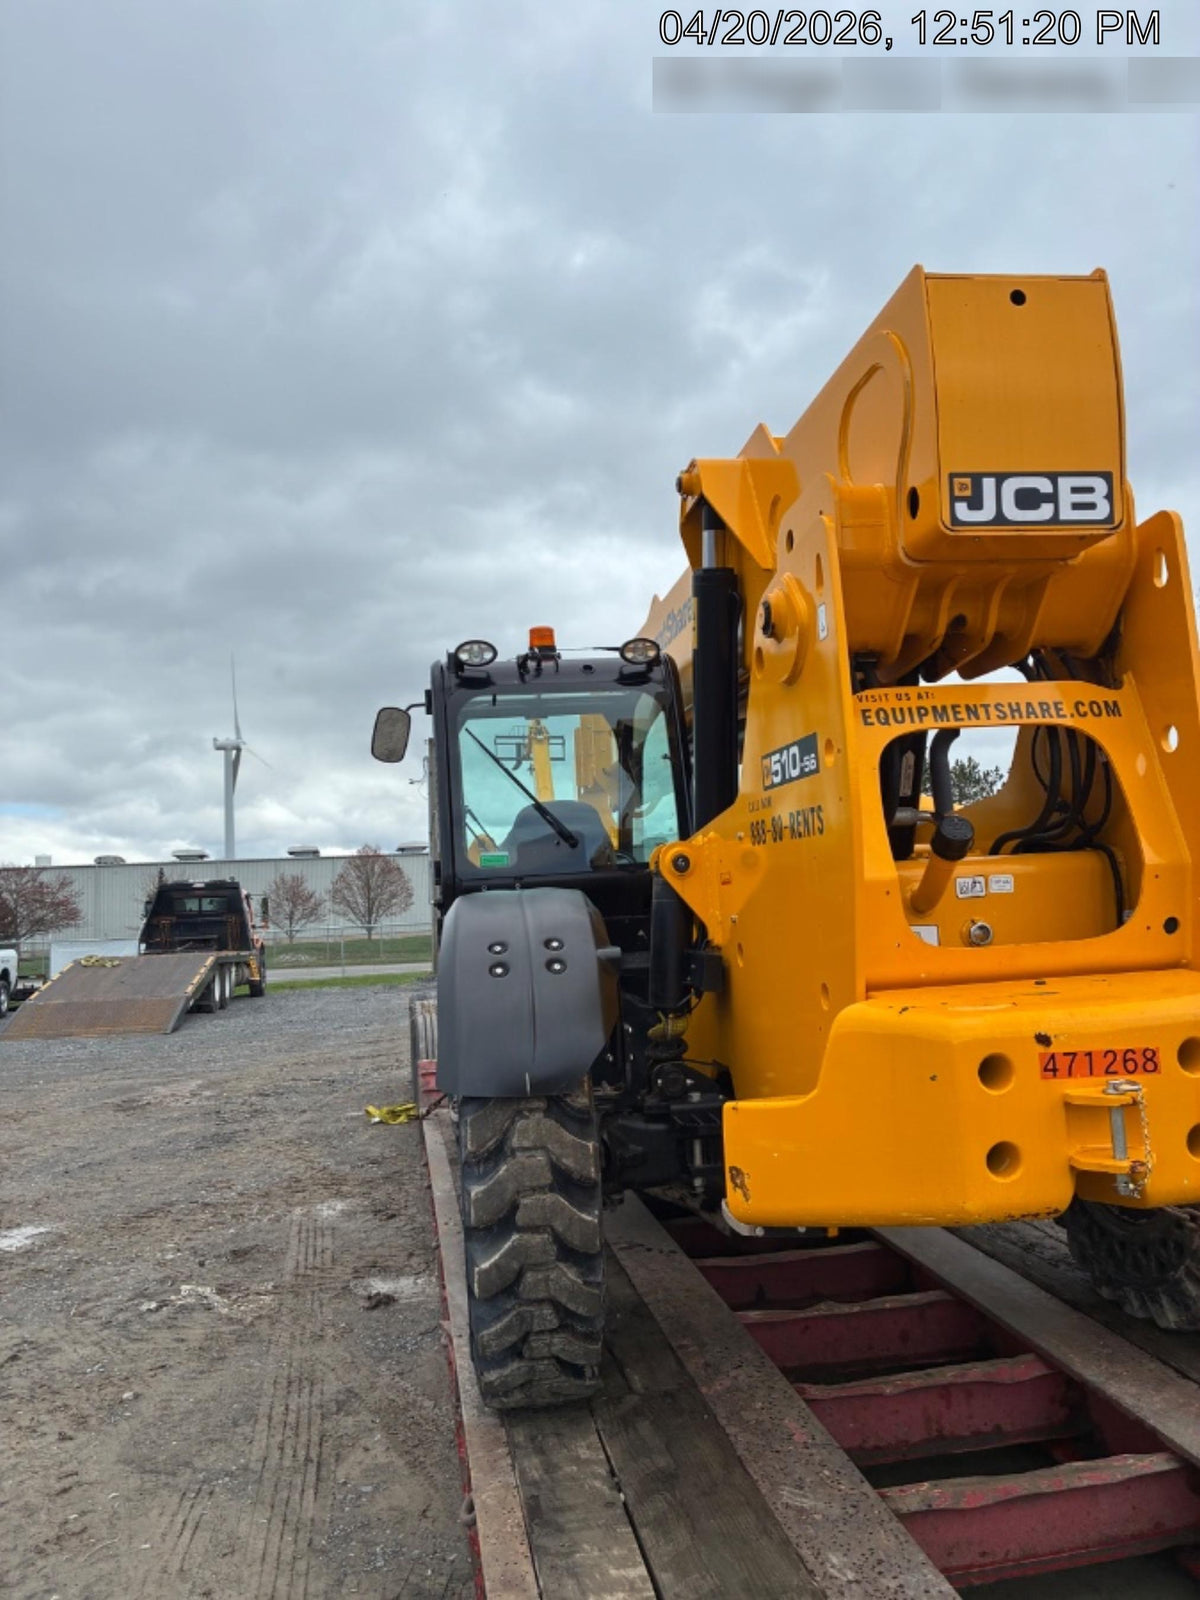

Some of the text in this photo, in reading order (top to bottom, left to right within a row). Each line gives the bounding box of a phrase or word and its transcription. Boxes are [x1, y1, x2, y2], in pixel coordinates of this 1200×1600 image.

[953, 475, 1112, 523] JCB
[857, 691, 935, 703] VISIT US AT:
[861, 699, 1122, 727] EQUIPMENTSHARE.COM
[1043, 1047, 1159, 1078] 471268
